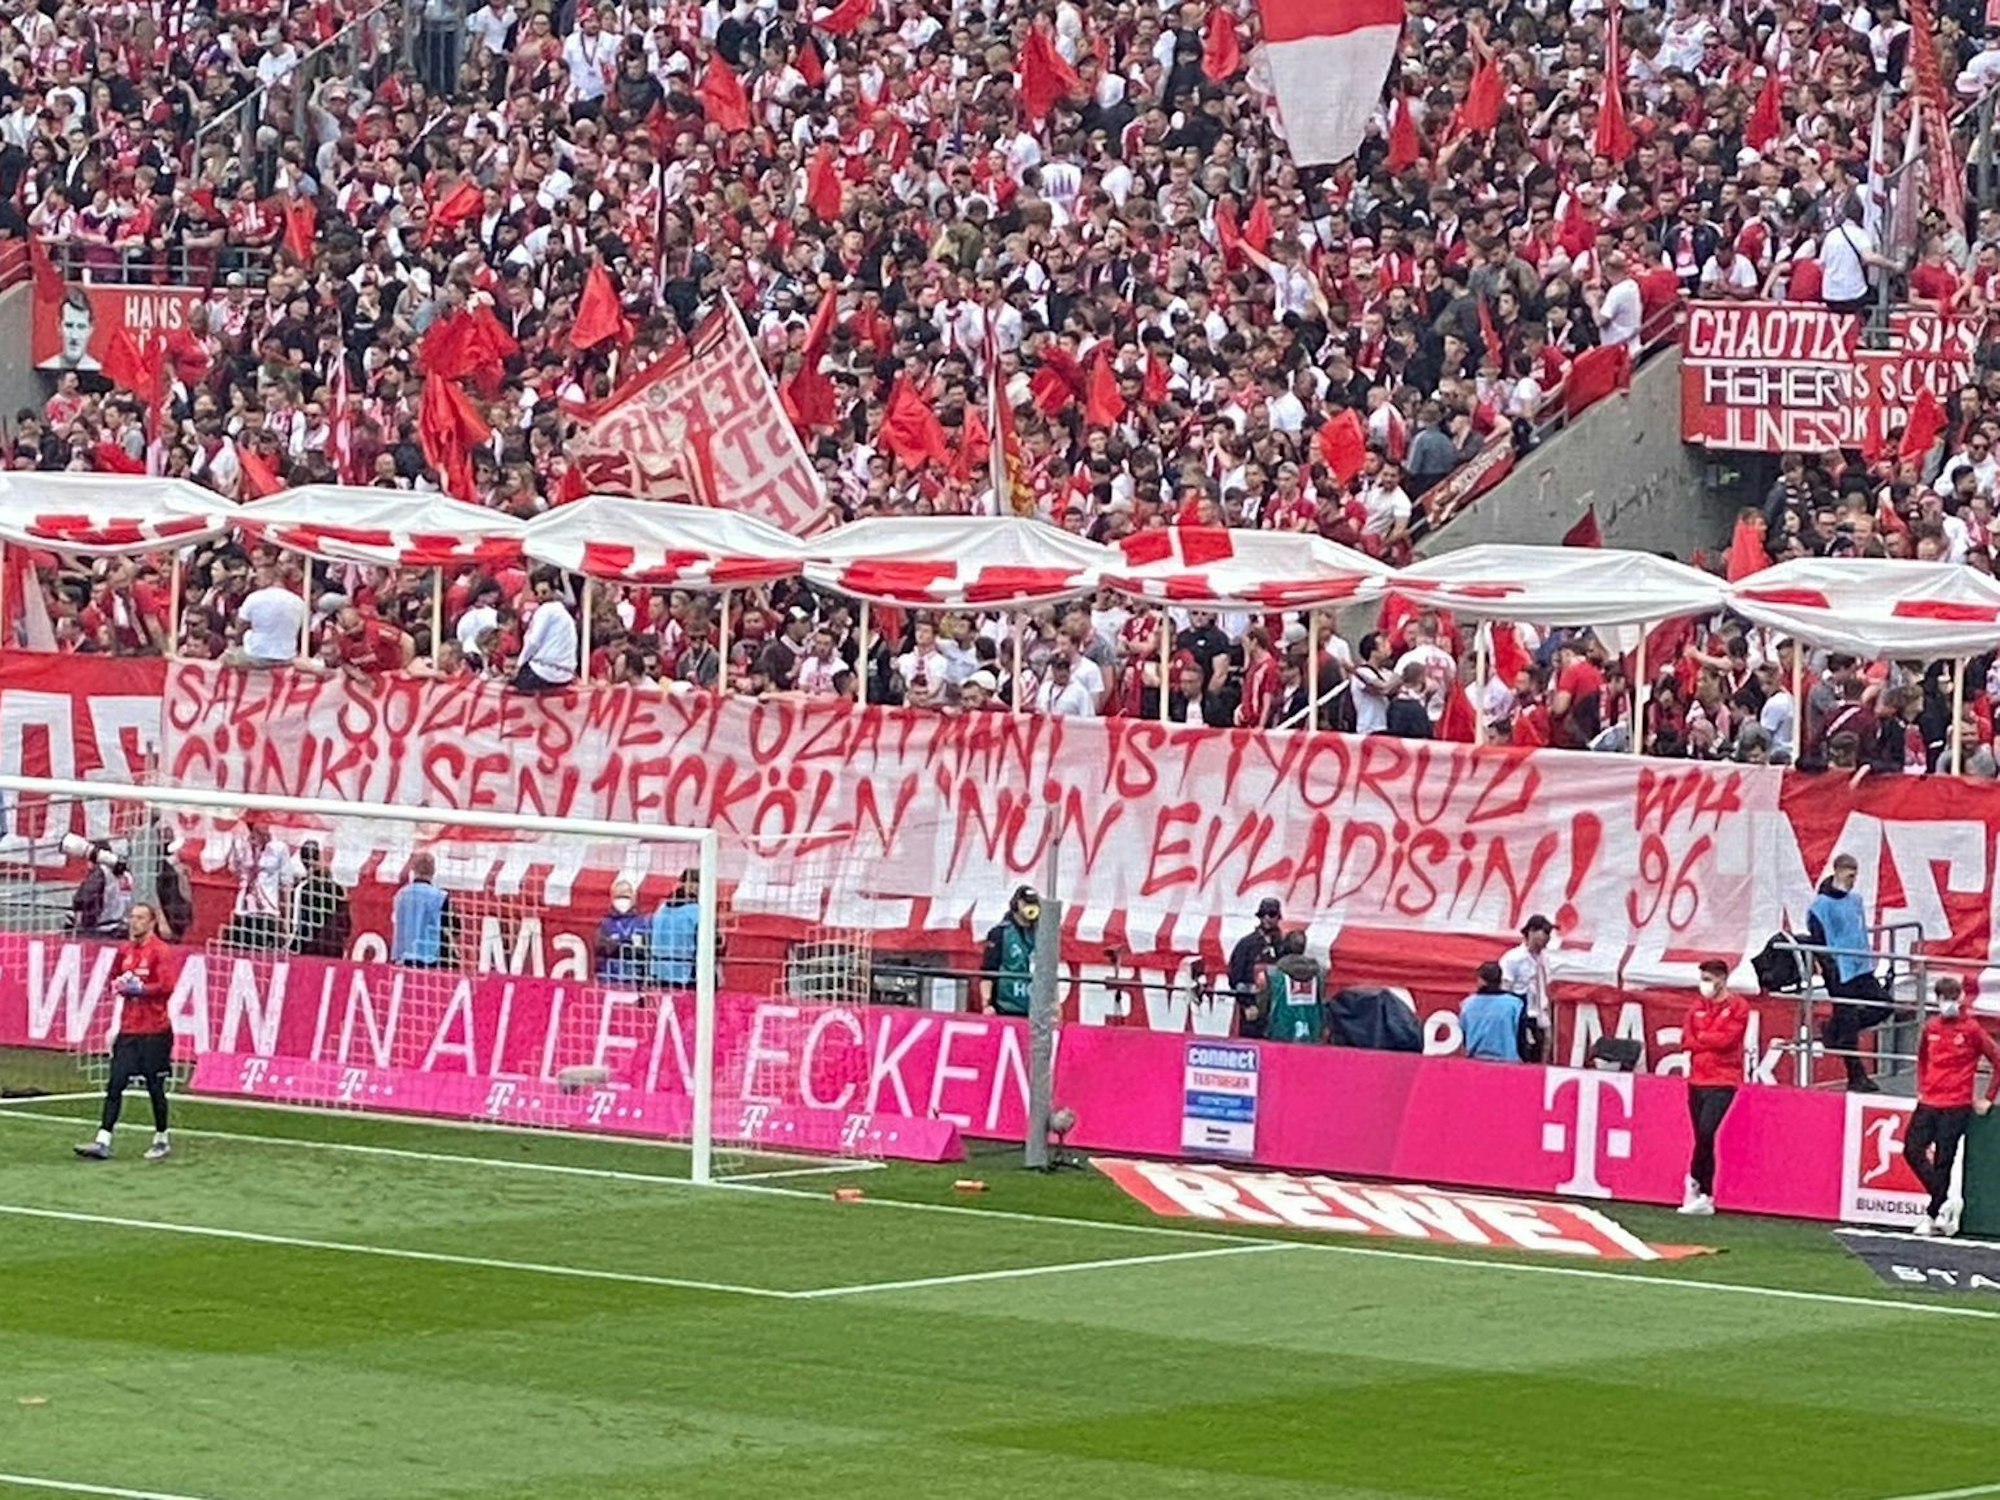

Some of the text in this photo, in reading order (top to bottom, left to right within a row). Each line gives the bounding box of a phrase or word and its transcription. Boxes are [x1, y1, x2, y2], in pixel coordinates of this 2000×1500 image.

[124, 296, 183, 330] HANS
[1688, 308, 1856, 362] CHAOTIX
[1704, 407, 1843, 452] JUNGS
[1626, 833, 1712, 931] 96
[310, 965, 403, 1070] IN
[1187, 1048, 1256, 1071] connect
[1132, 1161, 1602, 1256] REWE
[1856, 1197, 1926, 1216] BUNDESLI
